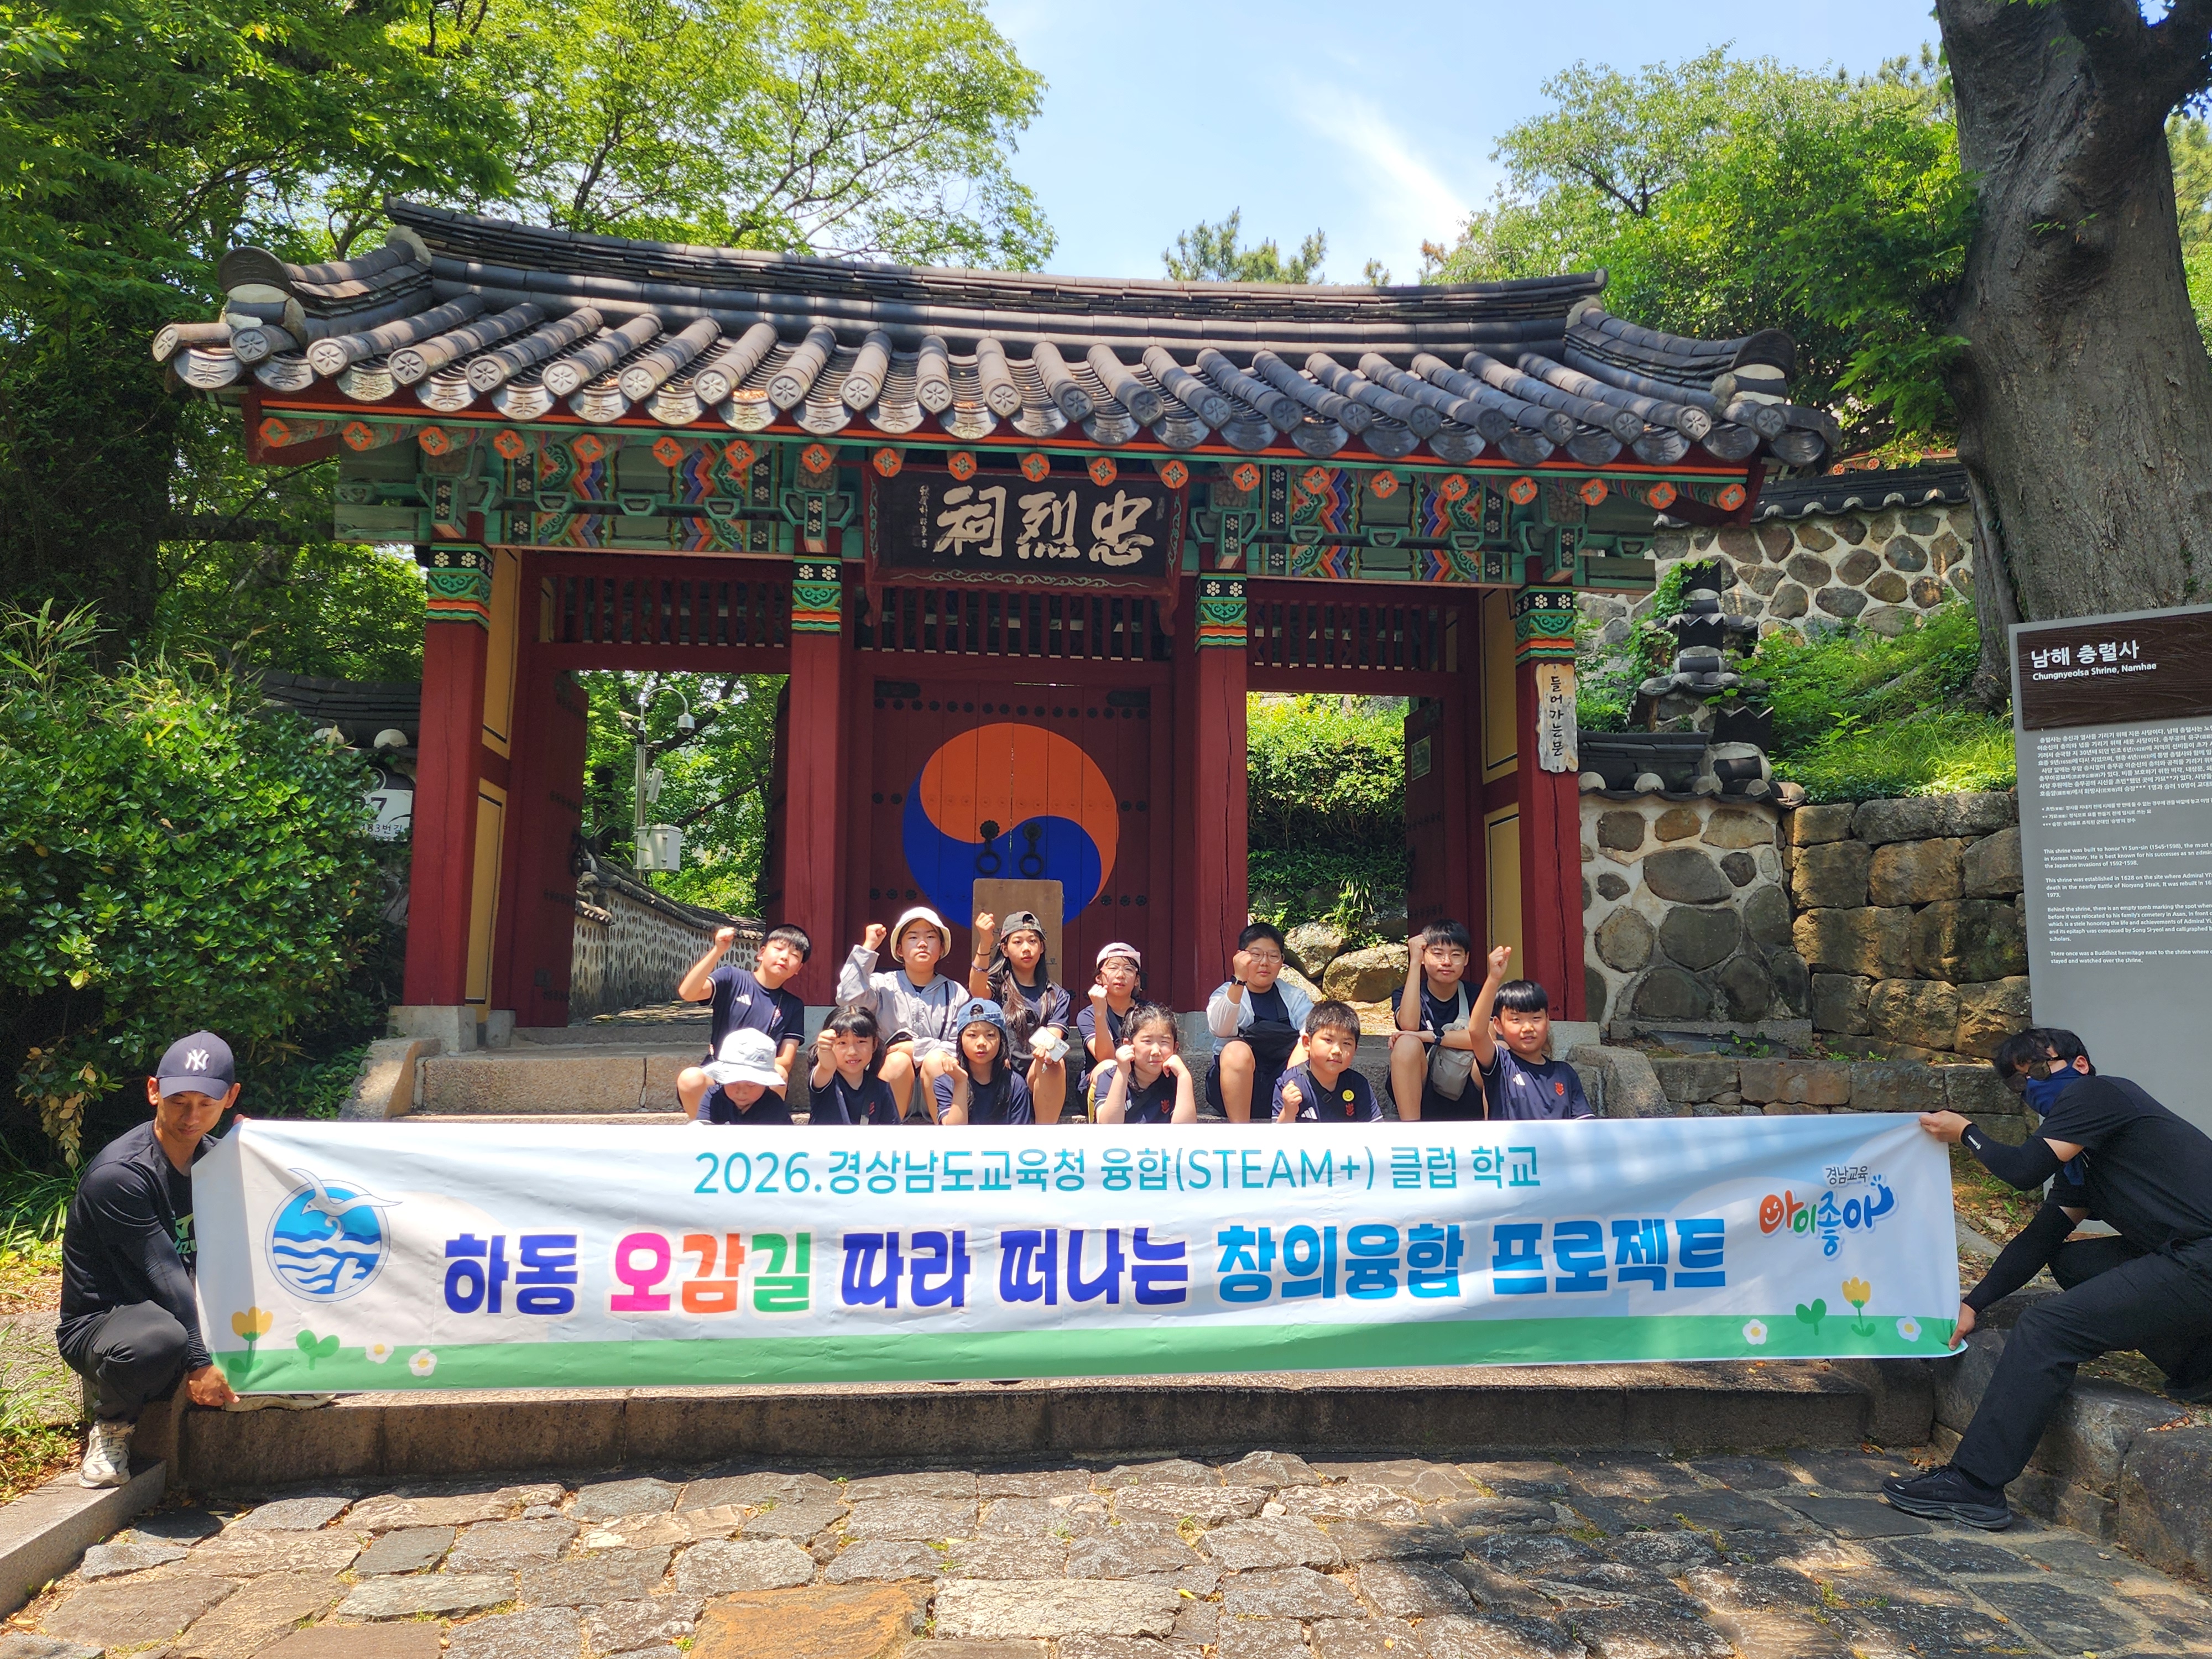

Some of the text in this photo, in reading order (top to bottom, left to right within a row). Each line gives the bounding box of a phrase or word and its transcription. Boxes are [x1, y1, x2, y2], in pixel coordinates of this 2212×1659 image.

[2031, 640, 2140, 669] 남해 충렬사
[2032, 662, 2157, 681] Chungnyeolsa Shrine, Namhae
[185, 1048, 210, 1071] NY
[694, 1145, 1541, 1194] 2026.경상남도교육청 융합(STEAM+) 클럽 학교
[1825, 1165, 1869, 1185] 경남교육
[1759, 1183, 1895, 1256] 아이좋아
[444, 1218, 1726, 1315] 하동 오감길 따라 떠나는 창의융합 프로젝트
